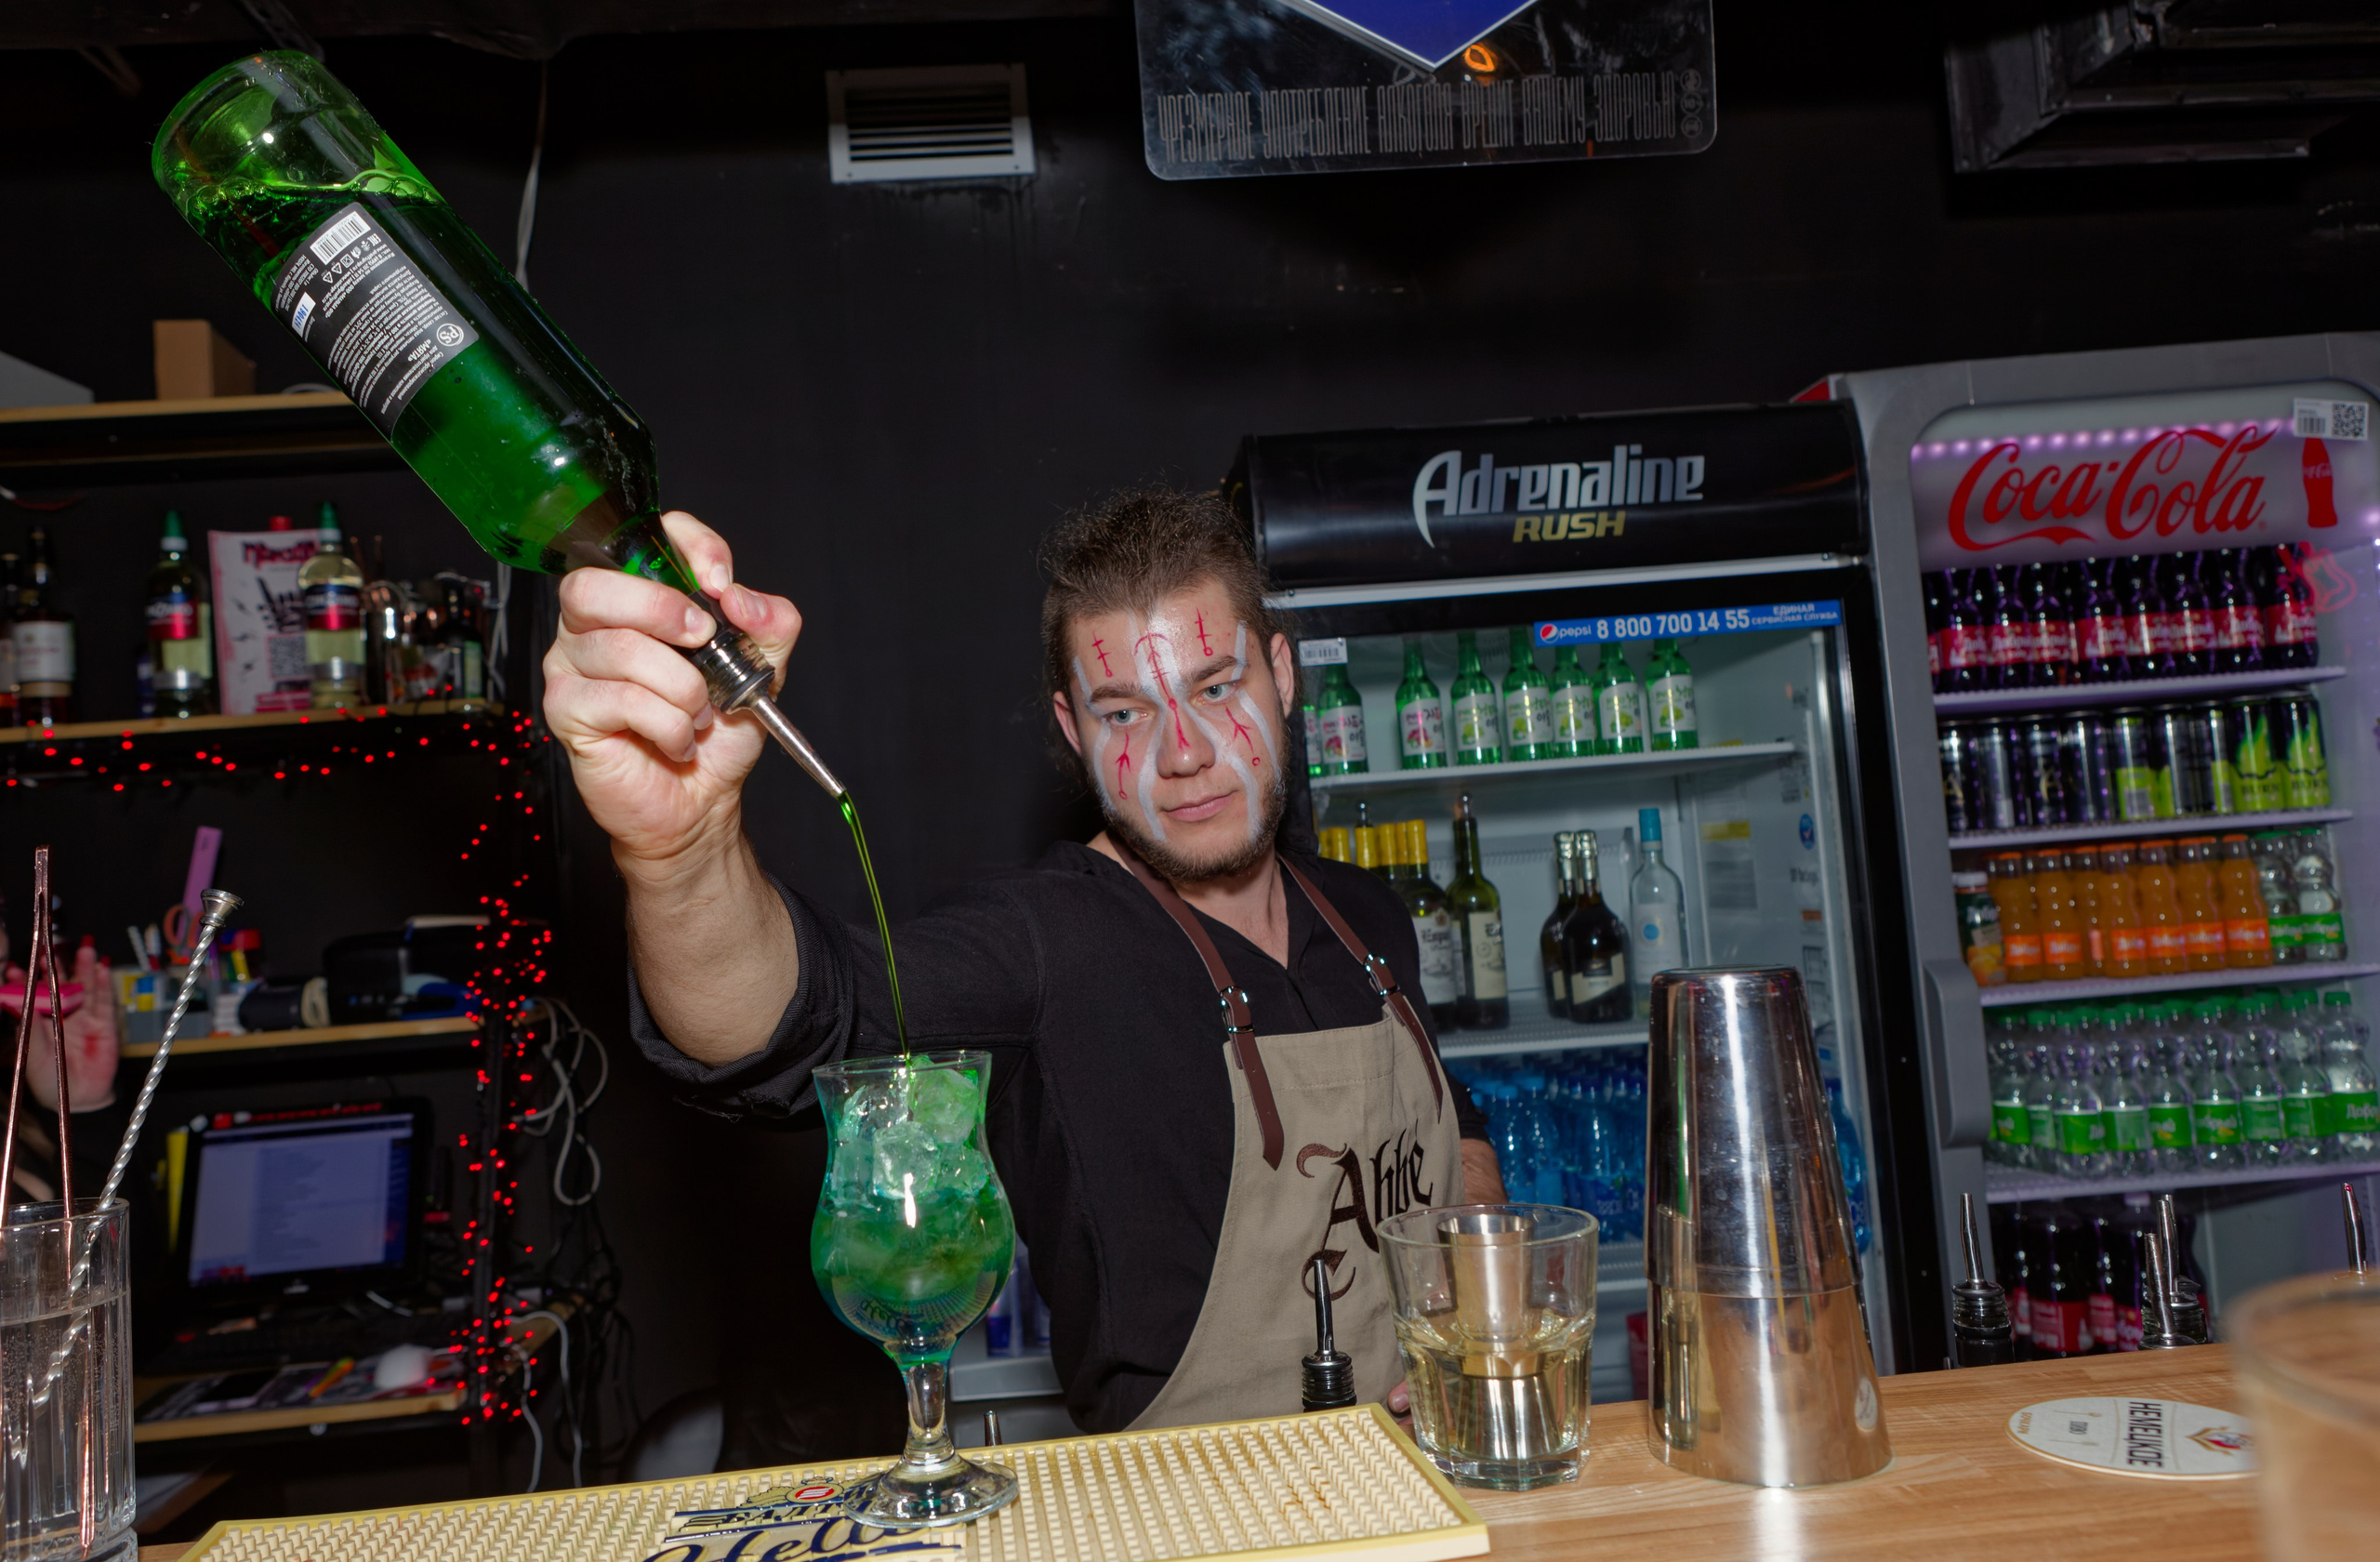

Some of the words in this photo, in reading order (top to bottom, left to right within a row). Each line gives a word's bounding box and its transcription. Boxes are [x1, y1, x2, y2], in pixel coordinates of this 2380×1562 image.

[1157, 92, 1256, 163] ЧРЕЗМЕРНОЕ
[1261, 86, 1371, 159] УПОТРЕБЛЕНИЕ
[1377, 83, 1455, 152] АЛКОГОЛЯ
[1461, 79, 1516, 148] ВРЕДИТ
[1522, 75, 1588, 145] ВАШЕМУ
[1592, 70, 1676, 142] ЗДОРОВЬЮ
[407, 338, 432, 362] «МЯТА»
[1412, 444, 1705, 549] Adrenaline
[1949, 426, 2280, 551] Coca-Cola
[1513, 510, 1626, 543] RUSH
[1596, 619, 1608, 639] 8
[1614, 617, 1652, 637] 800
[1656, 614, 1693, 634] 700
[1698, 611, 1720, 631] 14
[1725, 609, 1750, 629] 55
[1752, 613, 1803, 625] СЕРВИСНАЯ
[1803, 611, 1839, 623] СЛУЖБА
[1773, 602, 1815, 616] ЕДИНАЯ
[1559, 624, 1592, 640] pepsi
[2125, 1401, 2163, 1468] НЕМЕЦКОЕ
